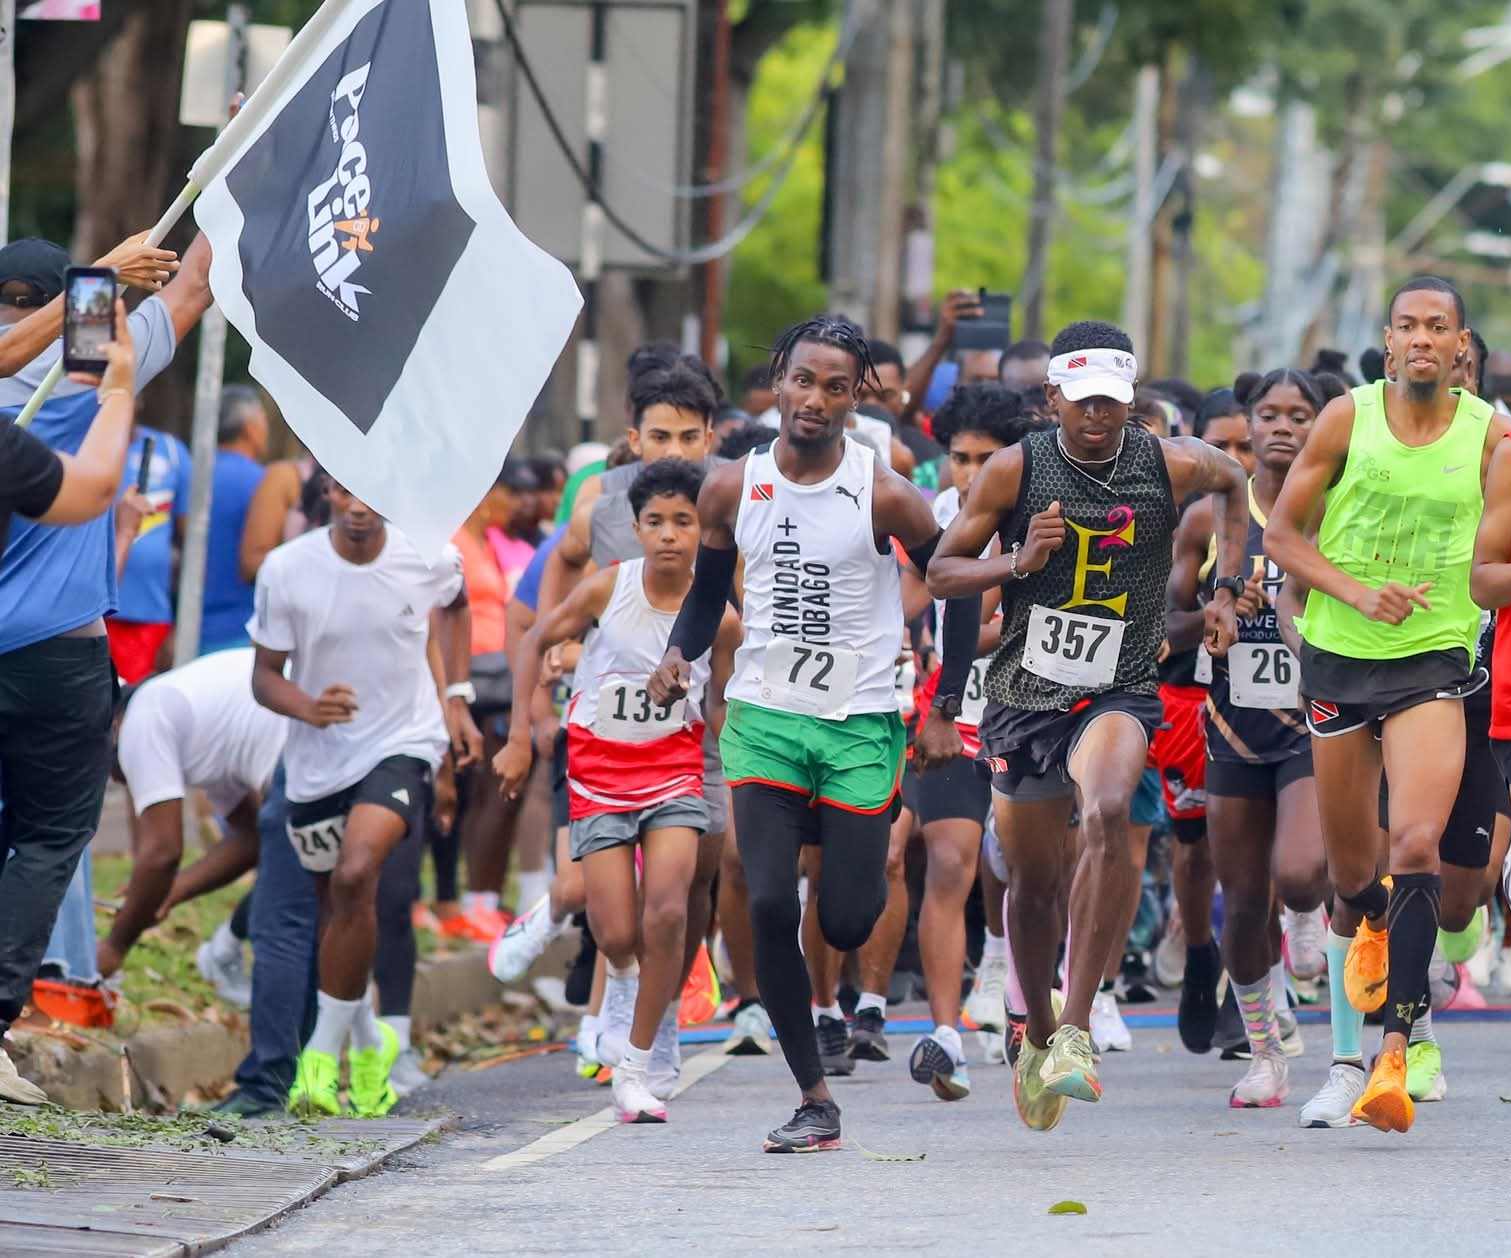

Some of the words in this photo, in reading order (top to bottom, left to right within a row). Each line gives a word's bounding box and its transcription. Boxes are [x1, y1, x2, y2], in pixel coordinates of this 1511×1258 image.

[308, 168, 373, 313] Link
[315, 280, 335, 302] RUN
[334, 300, 360, 322] CLUB
[770, 540, 801, 637] RINIDAD
[1041, 615, 1111, 663] 357
[788, 646, 835, 692] 72
[1251, 648, 1291, 684] 26
